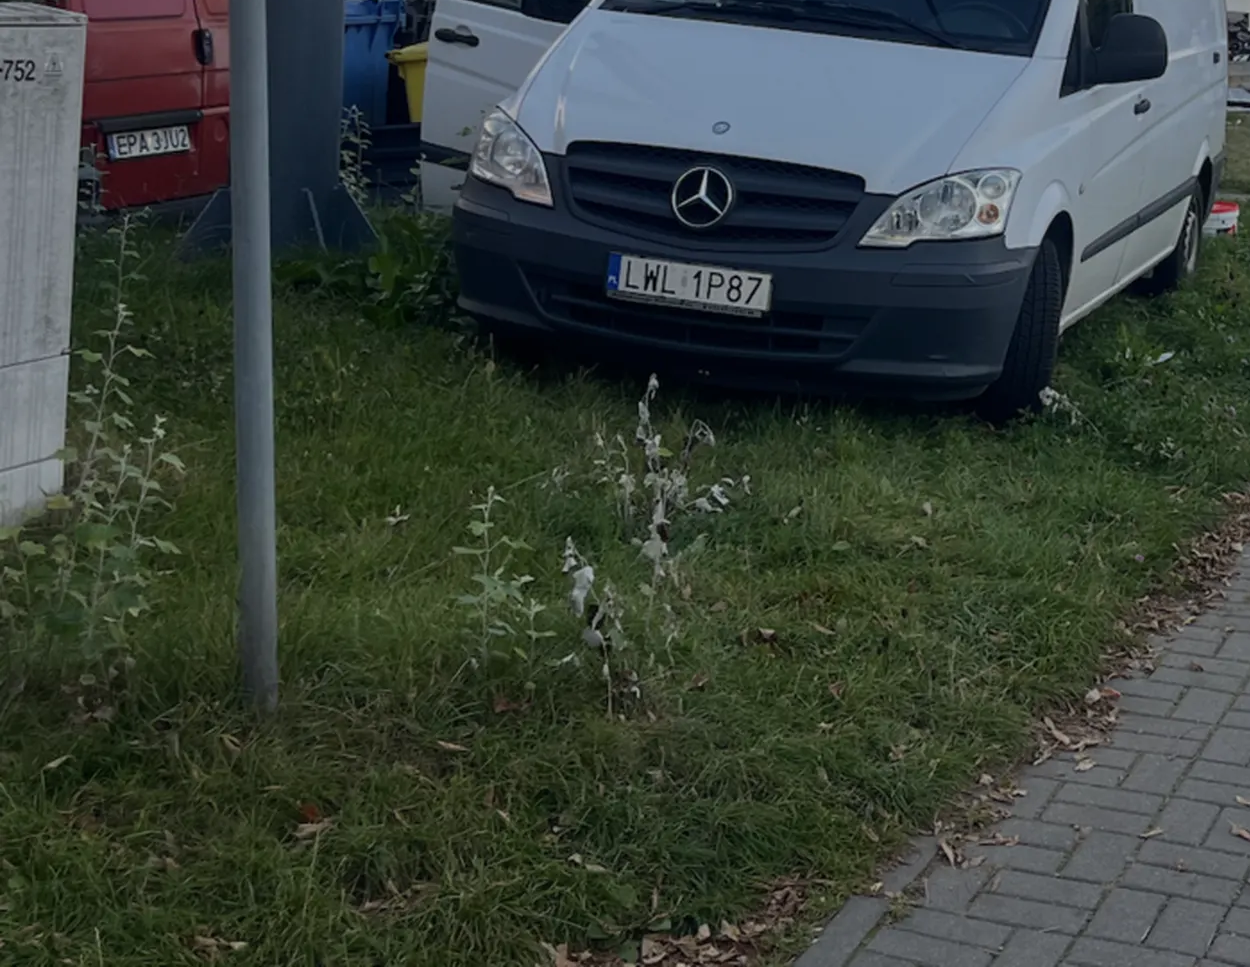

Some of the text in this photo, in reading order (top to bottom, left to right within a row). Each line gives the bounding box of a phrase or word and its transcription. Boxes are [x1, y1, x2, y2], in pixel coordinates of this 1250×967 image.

[116, 132, 150, 156] EPA
[624, 260, 763, 305] LWL 1P87
